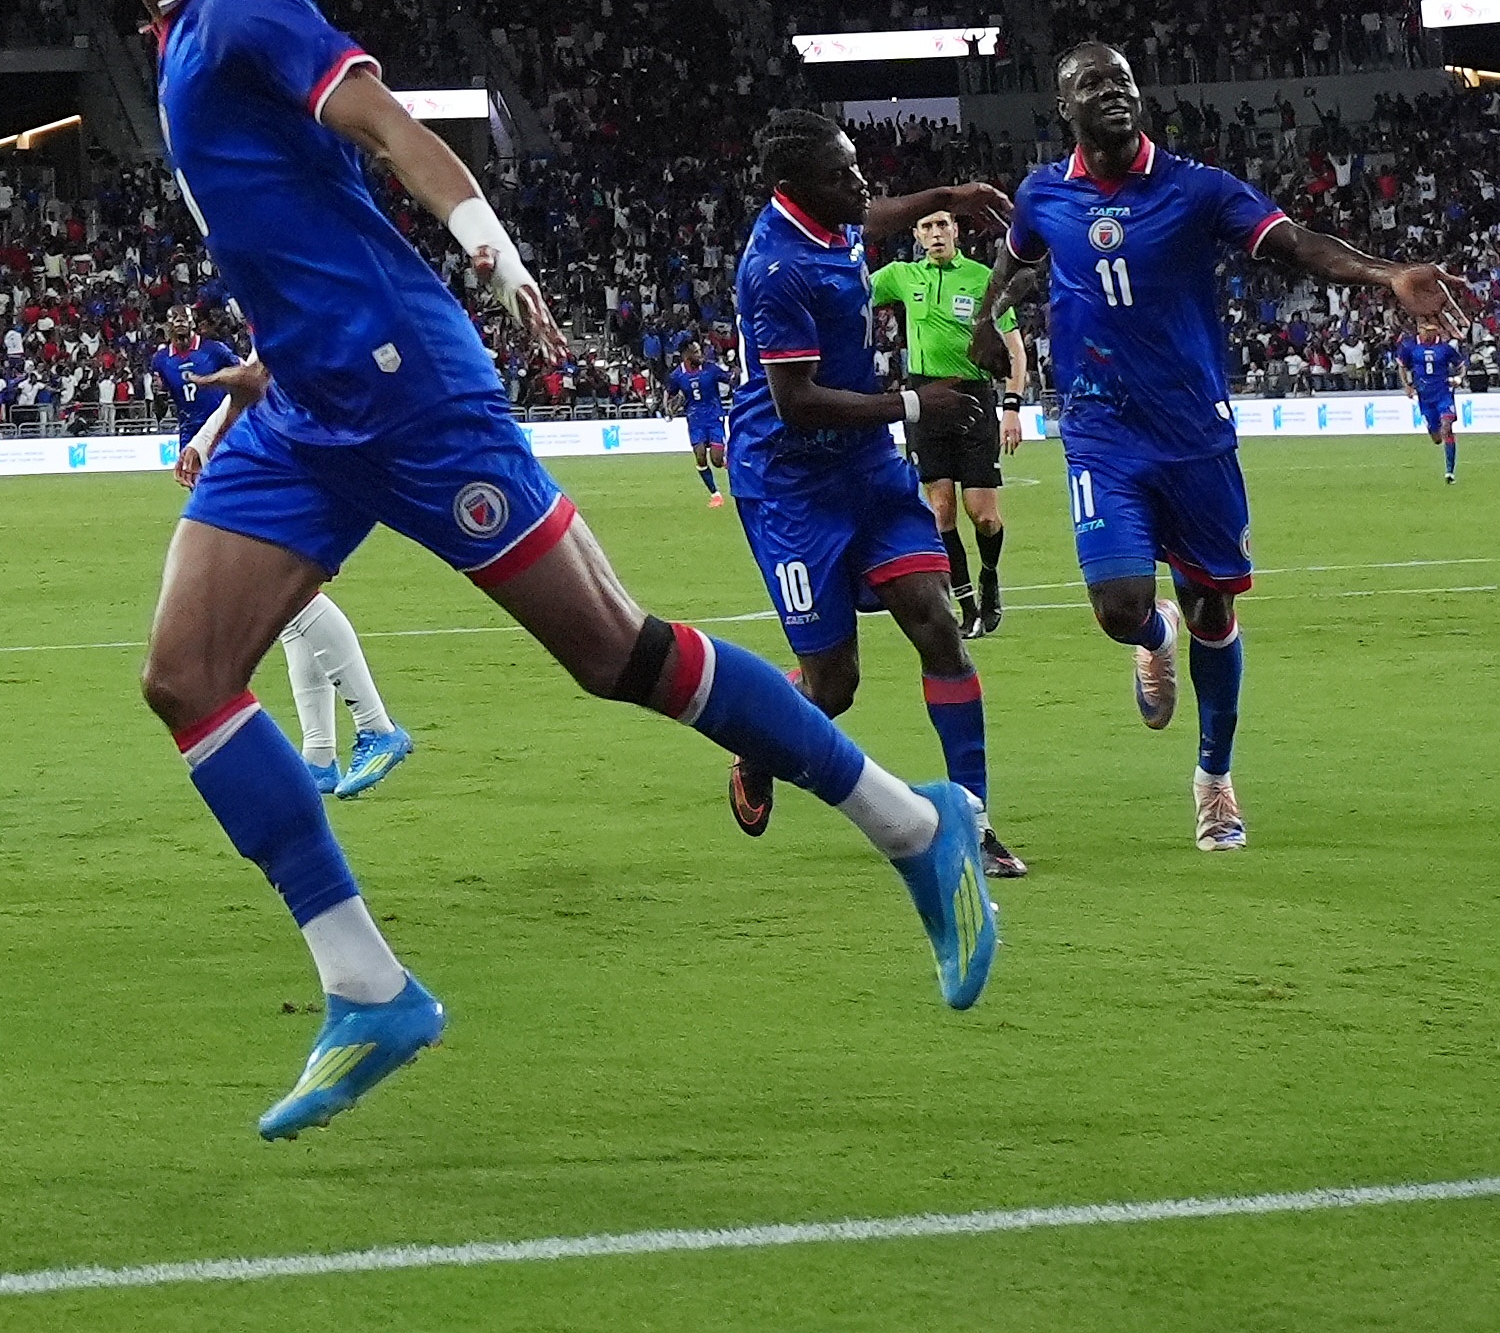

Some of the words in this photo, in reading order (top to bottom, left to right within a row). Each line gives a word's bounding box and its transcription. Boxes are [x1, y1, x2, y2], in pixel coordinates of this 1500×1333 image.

[1085, 206, 1131, 217] SAETA
[1094, 256, 1134, 307] 11
[181, 382, 197, 403] 17
[691, 388, 702, 401] 5
[774, 560, 813, 614] 10
[784, 611, 821, 626] SAETA
